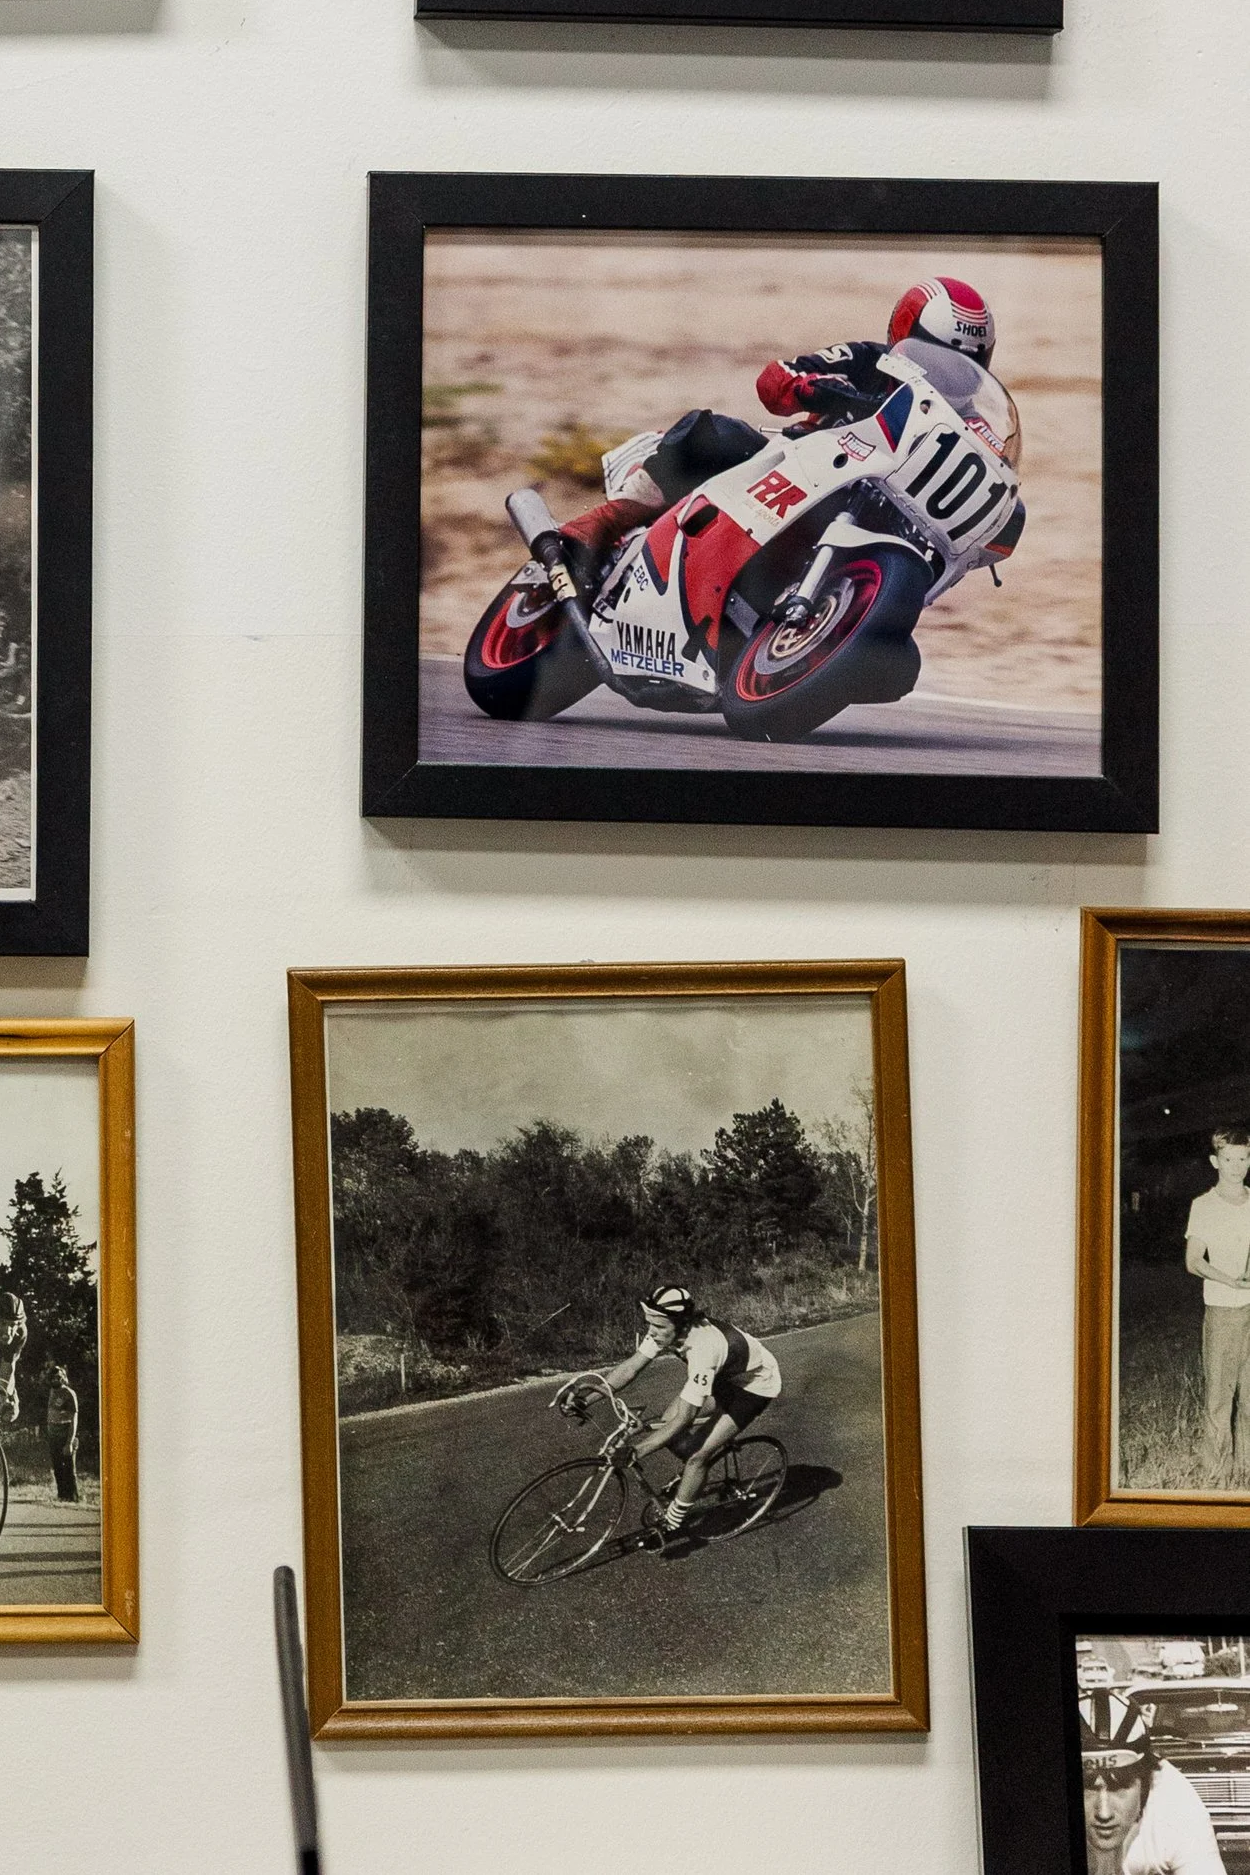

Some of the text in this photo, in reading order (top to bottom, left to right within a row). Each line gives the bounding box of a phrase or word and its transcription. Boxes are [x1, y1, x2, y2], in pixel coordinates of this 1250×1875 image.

[905, 431, 1009, 542] 101
[633, 565, 648, 591] EBC
[616, 621, 676, 662] YAMAHA
[610, 648, 685, 677] METZELER
[694, 1374, 707, 1386] 45
